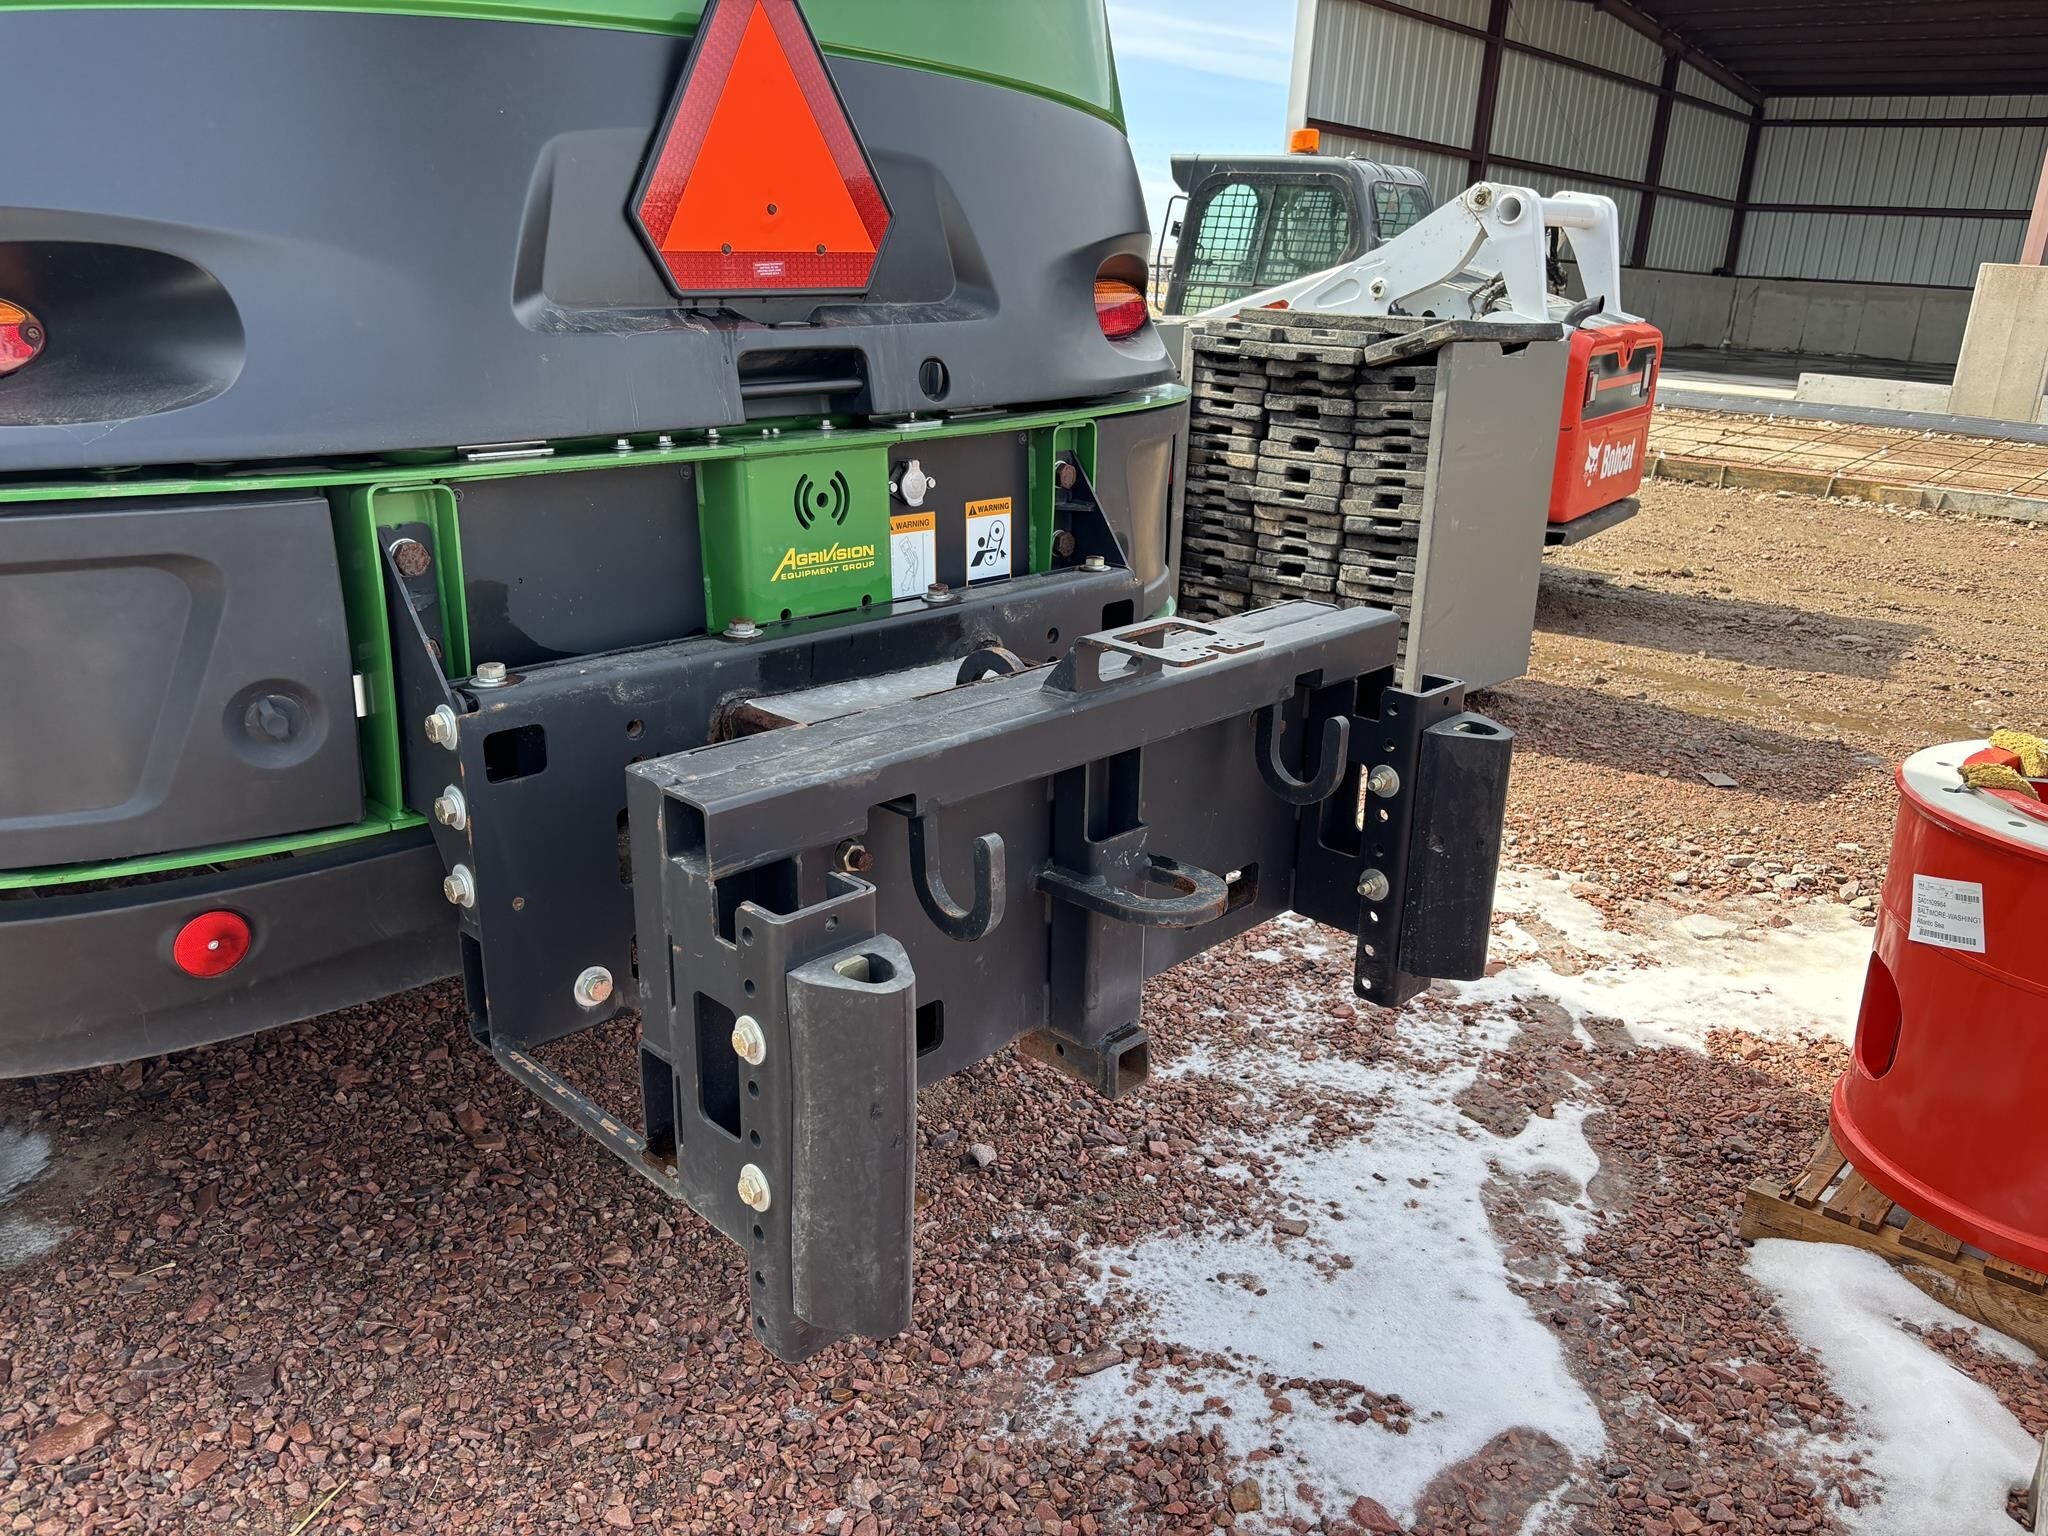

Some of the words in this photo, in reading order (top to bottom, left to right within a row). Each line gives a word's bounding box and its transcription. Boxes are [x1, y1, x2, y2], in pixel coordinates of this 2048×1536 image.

[1600, 437, 1637, 480] Bobcat
[977, 502, 1010, 513] WARNING
[896, 518, 930, 530] WARNING
[780, 566, 839, 581] EQUIPMENT
[842, 560, 875, 572] GROUP
